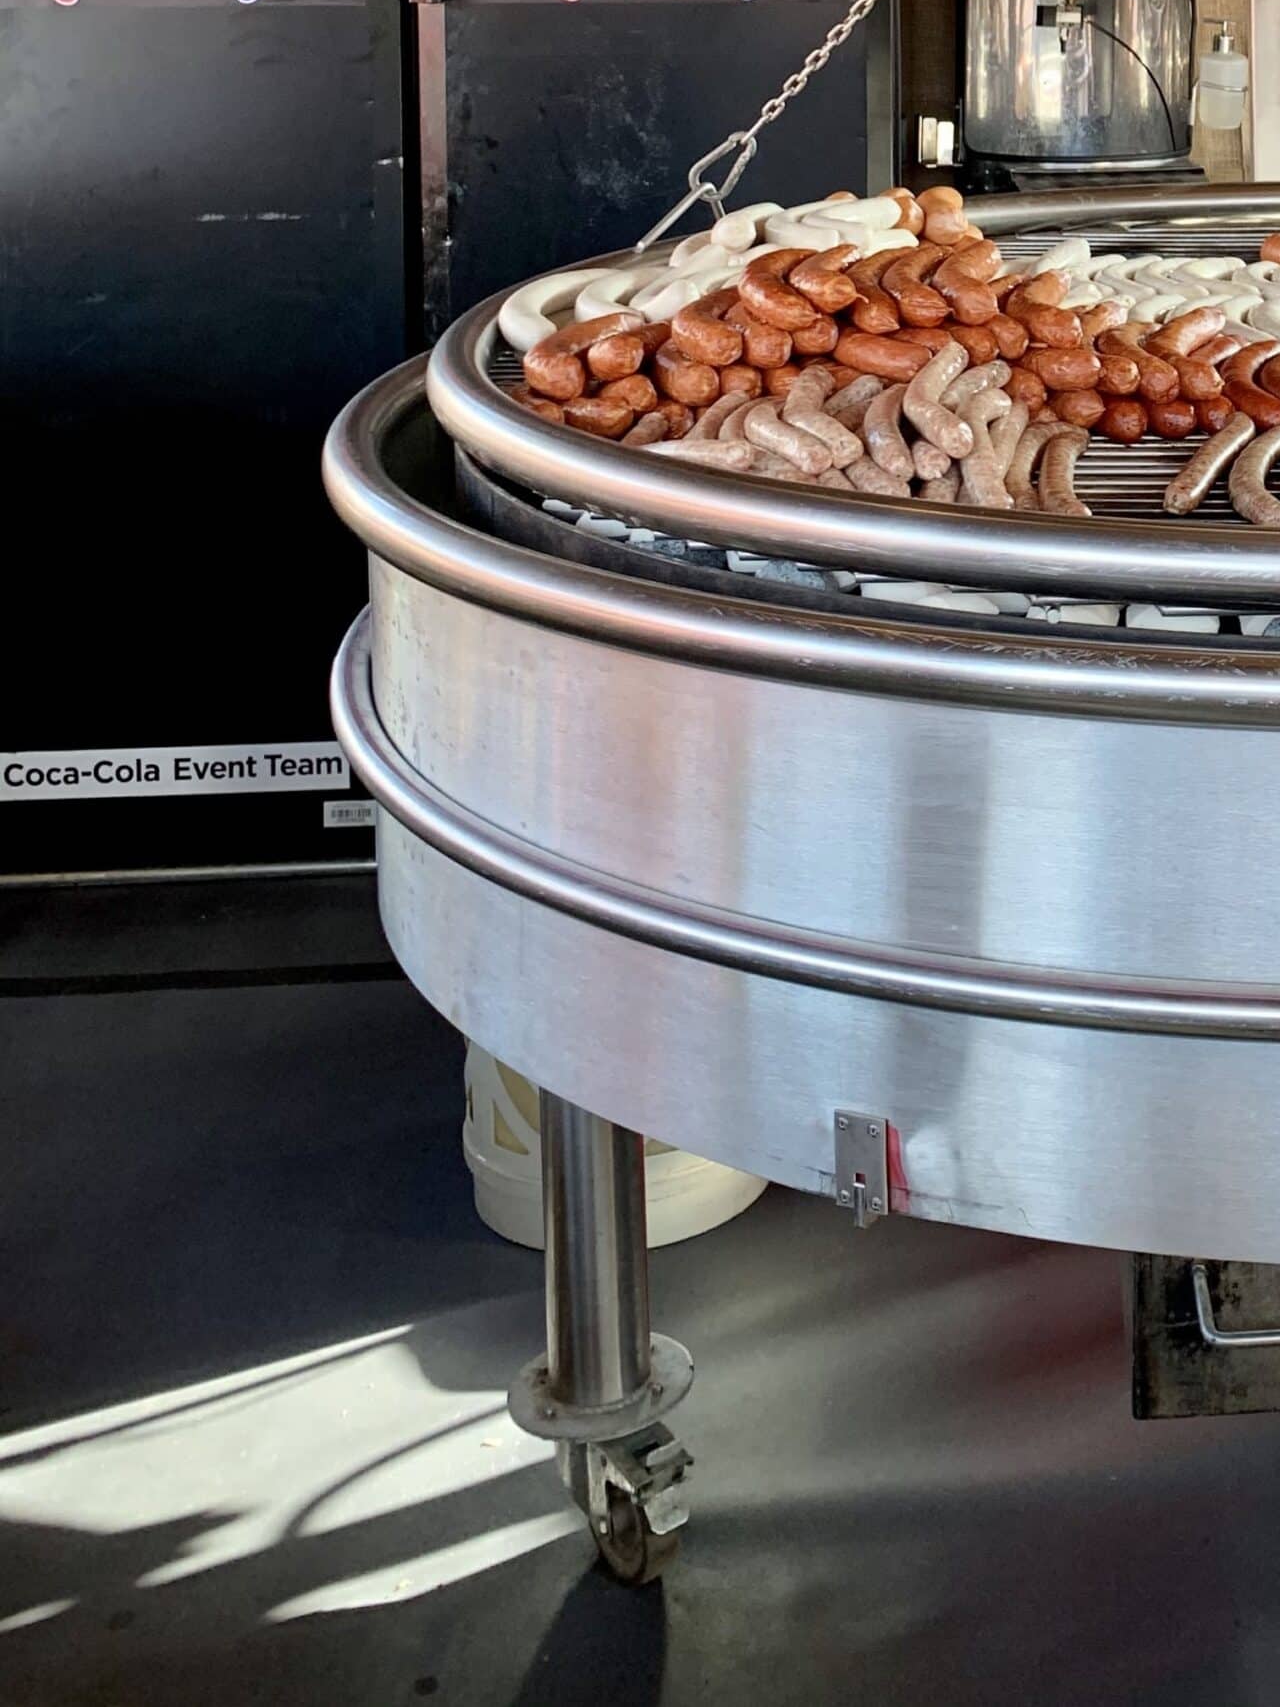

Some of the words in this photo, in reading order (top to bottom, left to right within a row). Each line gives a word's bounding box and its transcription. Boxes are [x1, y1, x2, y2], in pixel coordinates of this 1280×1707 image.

[3, 758, 160, 787] Coca-Cola
[173, 756, 256, 781] Event
[264, 753, 342, 777] Team
